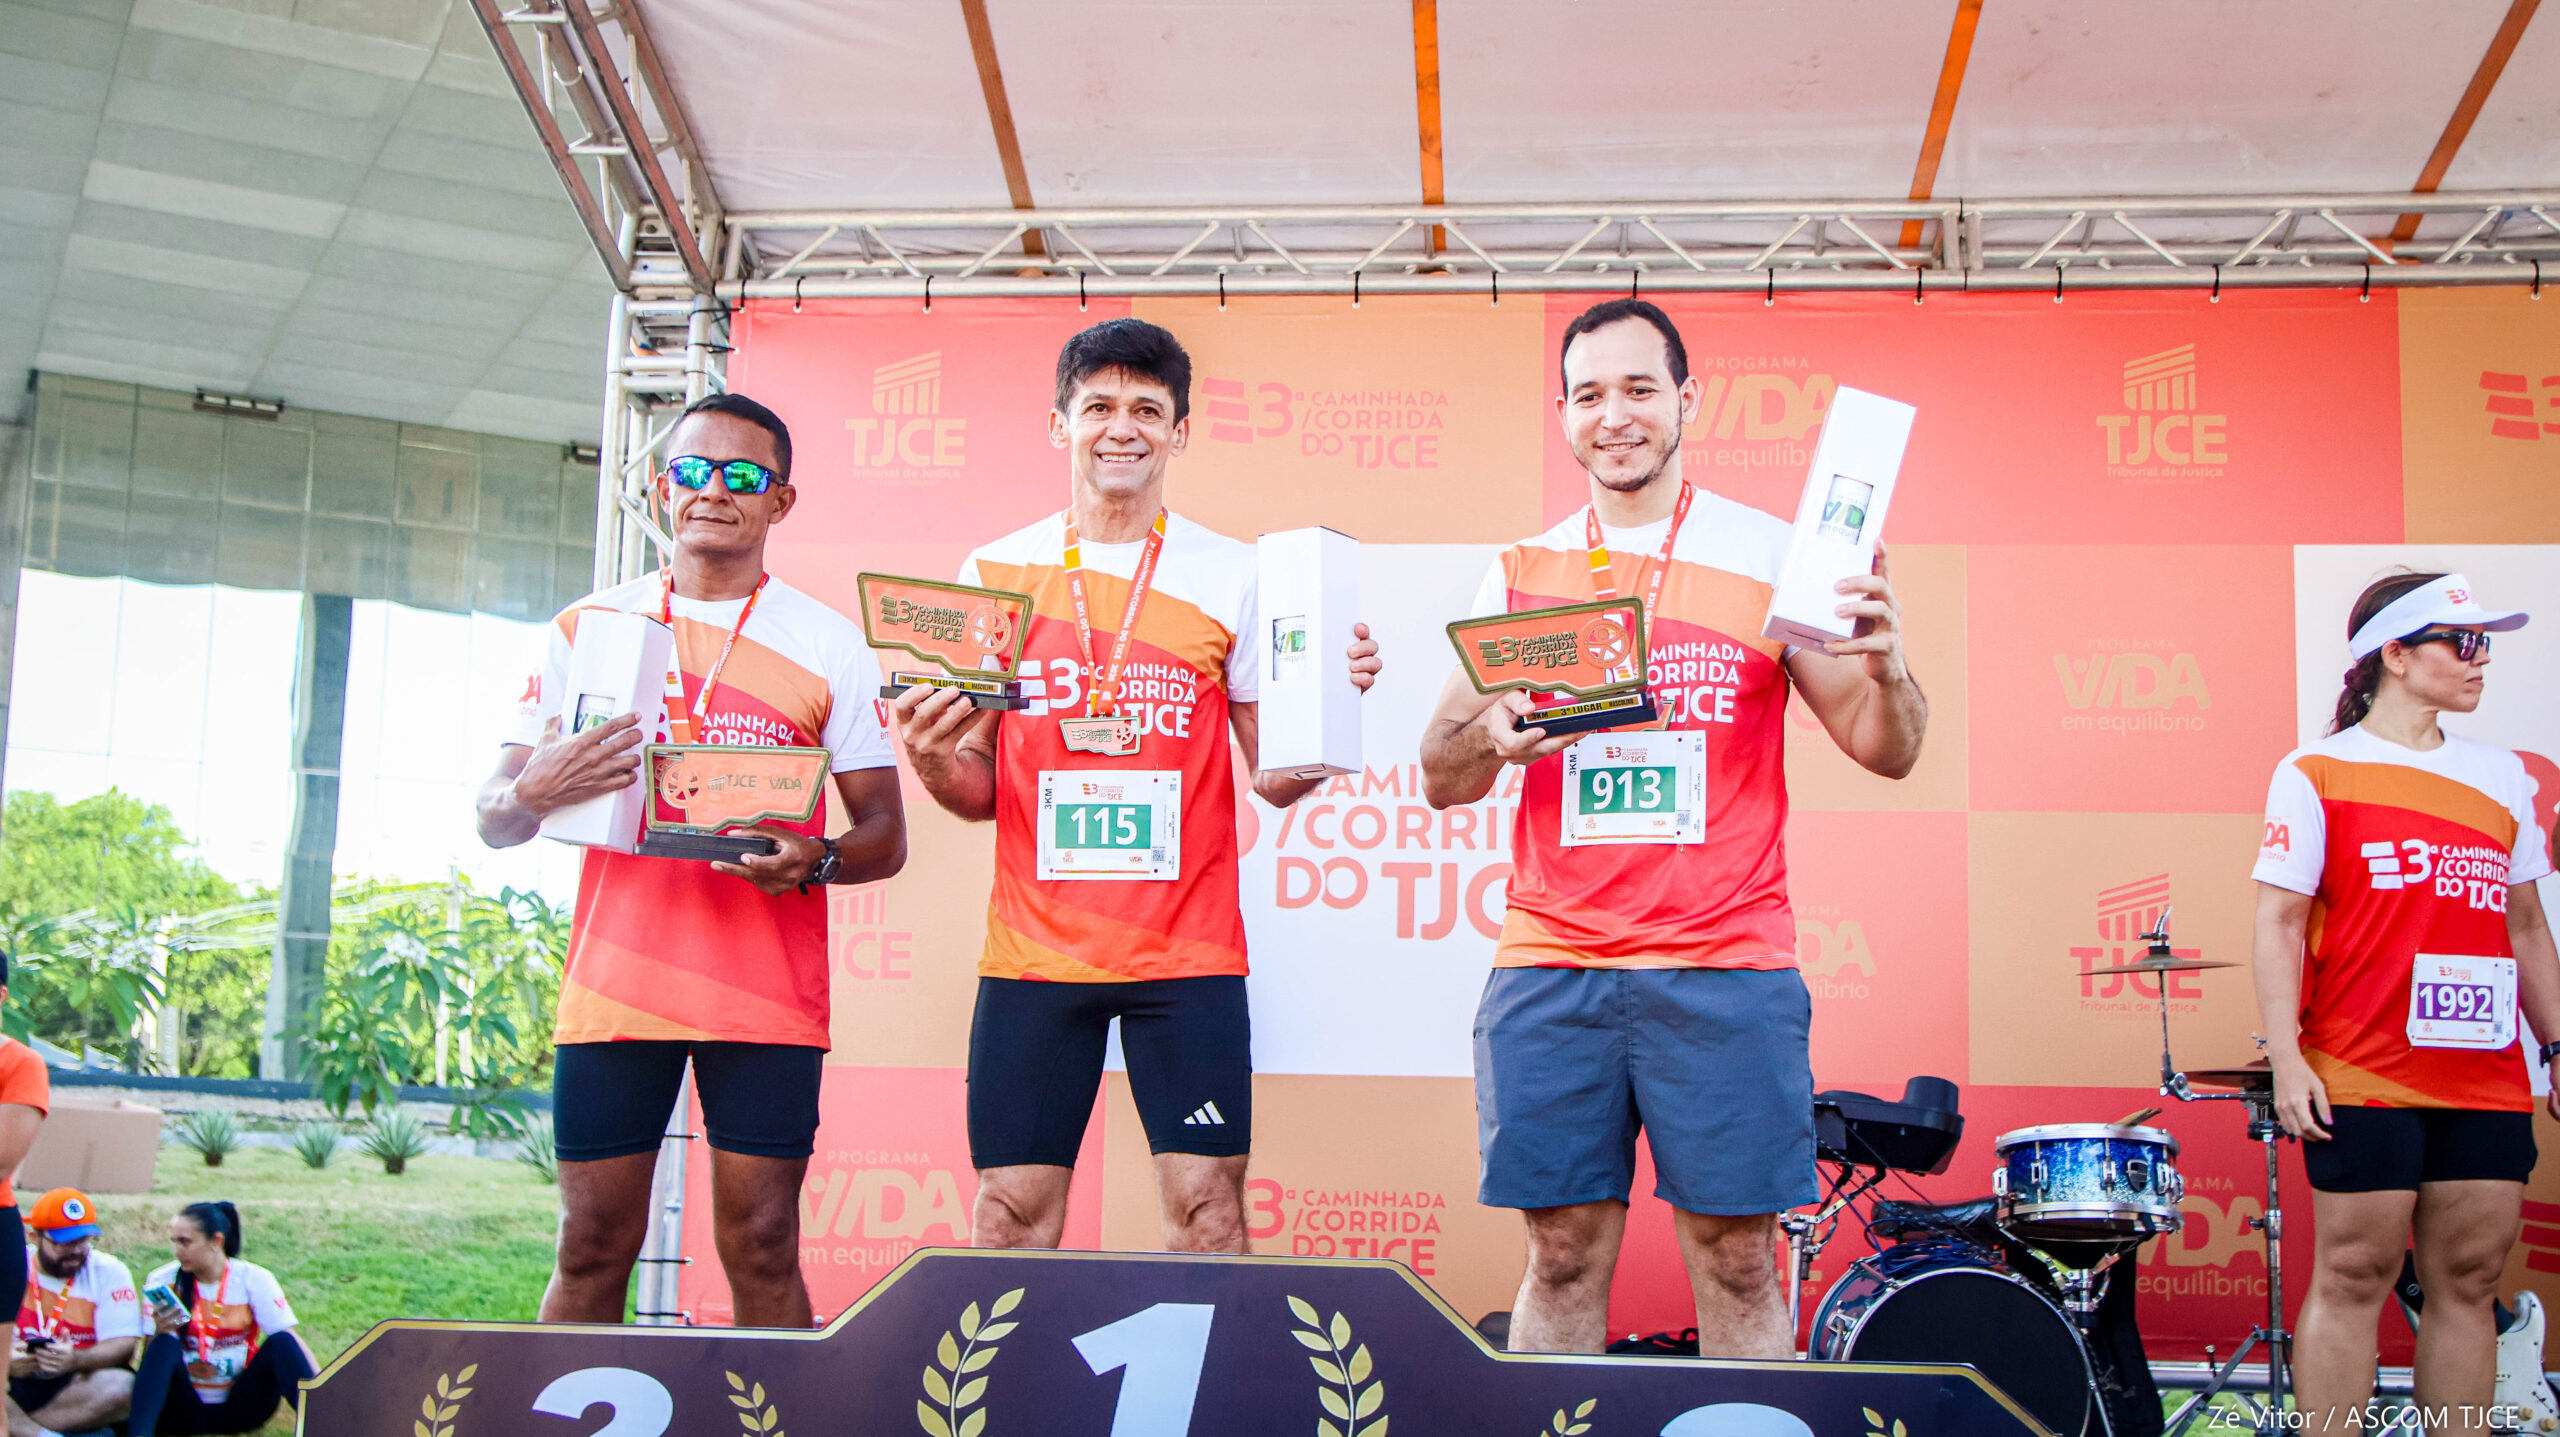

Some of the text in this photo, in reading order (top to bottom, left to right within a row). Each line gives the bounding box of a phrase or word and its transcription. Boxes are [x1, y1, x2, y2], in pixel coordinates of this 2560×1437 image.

[1705, 357, 1809, 370] PROGRAMA
[1311, 391, 1449, 407] CAMINHADA
[1302, 408, 1445, 430] /CORRIDA
[845, 417, 967, 467] TJCE
[1301, 433, 1439, 469] DO TJCE
[2096, 415, 2228, 465] TJCE
[2107, 466, 2158, 477] Tribunal
[2161, 467, 2177, 477] de
[918, 604, 967, 619] CAMINHADA
[913, 622, 962, 642] DO TJCE
[1522, 631, 1578, 647] CAMINHADA
[2088, 639, 2176, 649] PROGRAMA
[1522, 651, 1578, 668] DO TJCE
[2053, 653, 2213, 710] VIDA
[1573, 703, 1603, 714] LUGAR
[2062, 711, 2205, 736] em equilíbrio
[1569, 754, 1577, 776] 3KM
[726, 774, 757, 788] TJCE
[1592, 769, 1662, 811] 913
[1045, 788, 1053, 810] 3KM
[1070, 807, 1138, 845] 115
[1276, 856, 1368, 909] DO
[2435, 877, 2464, 897] DO
[2080, 1000, 2131, 1012] Tribunal
[2136, 1001, 2151, 1012] de
[2419, 985, 2492, 1020] 1992
[827, 1151, 931, 1164] PROGRAMA
[1303, 1189, 1446, 1209] CAMINHADA
[1292, 1208, 1441, 1235] /CORRIDA
[1292, 1235, 1337, 1258] DO
[1072, 1303, 1214, 1437] 1
